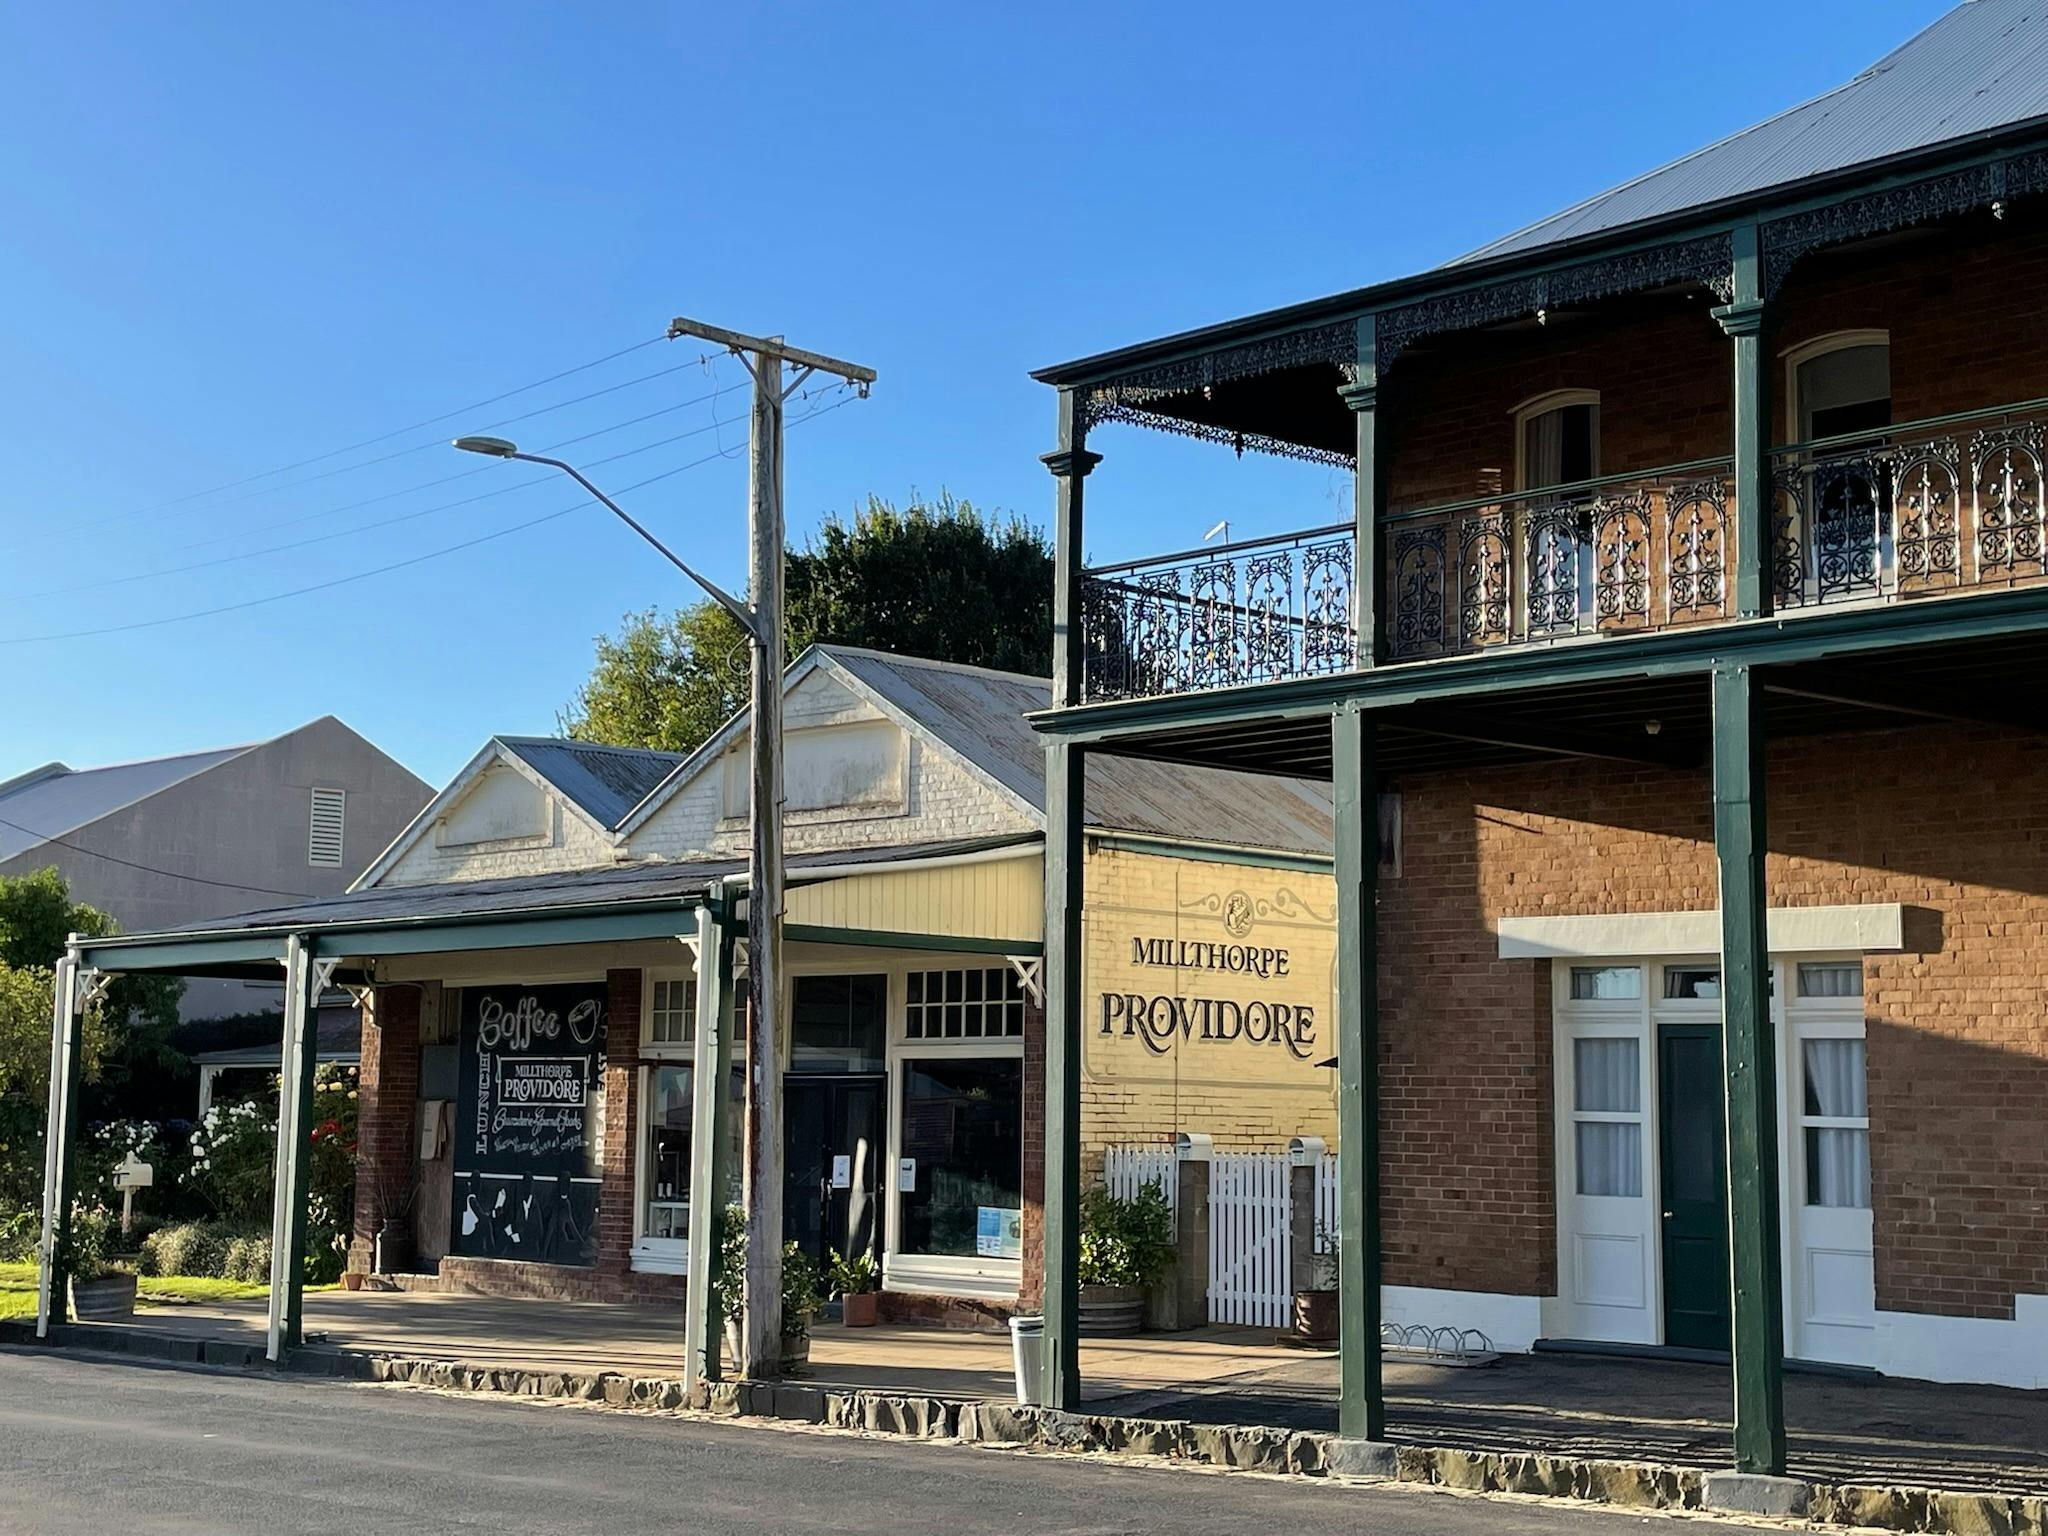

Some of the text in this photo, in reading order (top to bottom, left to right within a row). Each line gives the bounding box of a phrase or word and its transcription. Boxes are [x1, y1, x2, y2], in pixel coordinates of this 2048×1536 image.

[1132, 936, 1290, 979] MILLTHORPE
[478, 996, 562, 1050] Coffee
[1099, 992, 1317, 1060] PROVIDORE
[503, 1078, 581, 1102] PROVIDORE
[514, 1064, 573, 1080] MILLTHORPE
[475, 1052, 491, 1155] LUNCH
[594, 1051, 608, 1166] BREAKFAST
